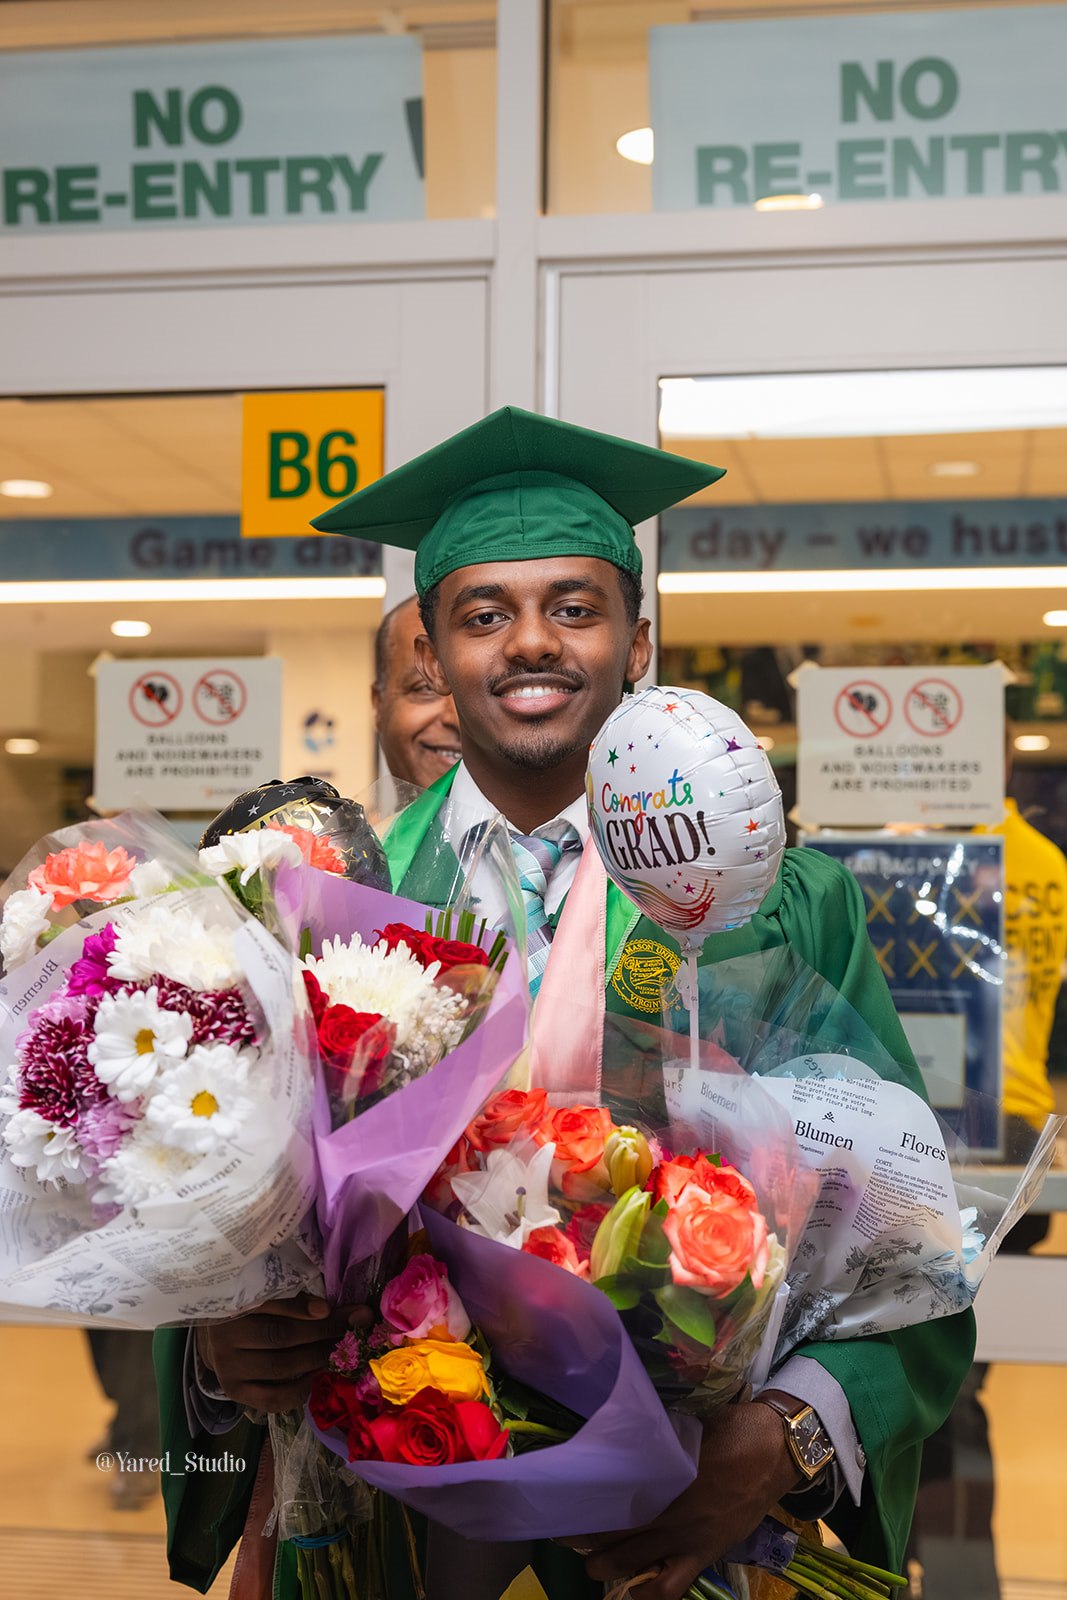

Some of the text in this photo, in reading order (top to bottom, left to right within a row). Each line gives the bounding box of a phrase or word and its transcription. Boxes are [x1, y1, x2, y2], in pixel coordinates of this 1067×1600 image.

[840, 56, 960, 124] NO
[133, 85, 243, 148] NO
[695, 130, 1067, 206] RE-ENTR
[2, 152, 384, 226] RE-ENTRY
[268, 430, 359, 500] B6
[129, 527, 275, 571] Game
[689, 518, 788, 568] day
[857, 523, 930, 559] we
[116, 750, 148, 762] AND
[147, 733, 229, 745] BALLOONS
[854, 744, 944, 757] BALLOONS
[124, 766, 154, 778] ARE
[820, 760, 982, 774] AND NOISEMAKERS
[830, 778, 972, 792] ARE PROHIBITED
[602, 768, 694, 835] Congrats
[606, 810, 716, 870] GRAD!
[625, 943, 654, 956] MASON
[700, 1082, 738, 1113] Bloemen
[795, 1120, 854, 1151] Blumen
[900, 1132, 946, 1161] Flores
[176, 1157, 242, 1199] Bloemen
